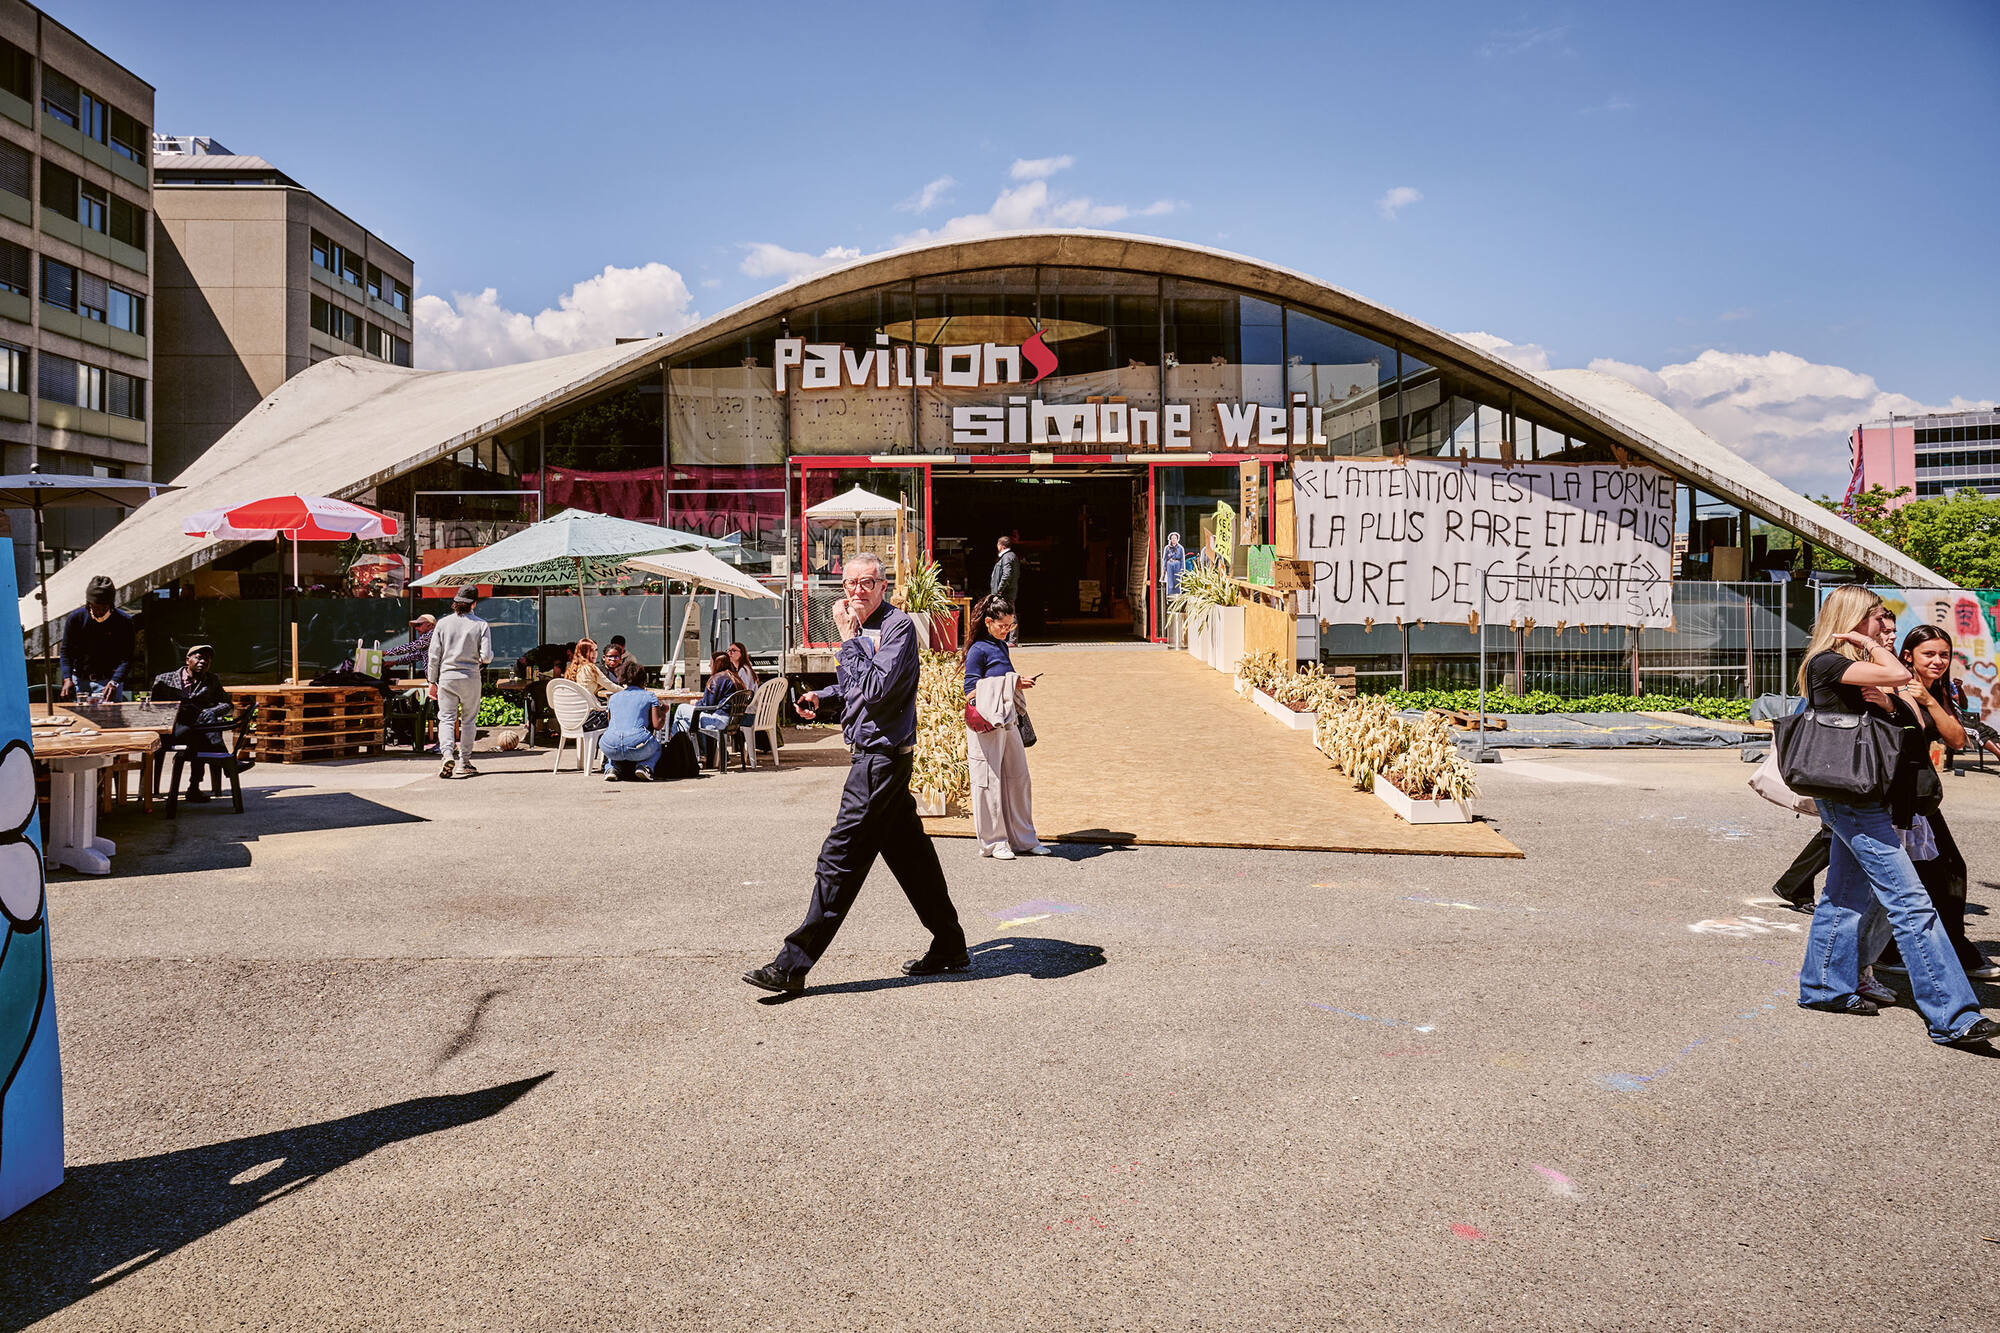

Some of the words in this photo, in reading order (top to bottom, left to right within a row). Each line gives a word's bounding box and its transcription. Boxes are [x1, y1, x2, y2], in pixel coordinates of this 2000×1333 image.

[1491, 471, 1541, 503] EST
[1550, 472, 1582, 502] LA
[1592, 469, 1674, 510] FORME
[1308, 513, 1346, 549] LA
[1359, 508, 1425, 544] PLUS
[1446, 508, 1532, 549] RARE
[1545, 510, 1576, 547] ET
[1580, 509, 1608, 545] LA
[1617, 507, 1671, 549] PLUS
[507, 571, 573, 584] WOMAN
[1311, 559, 1408, 606] PURE
[1431, 562, 1473, 606] DE
